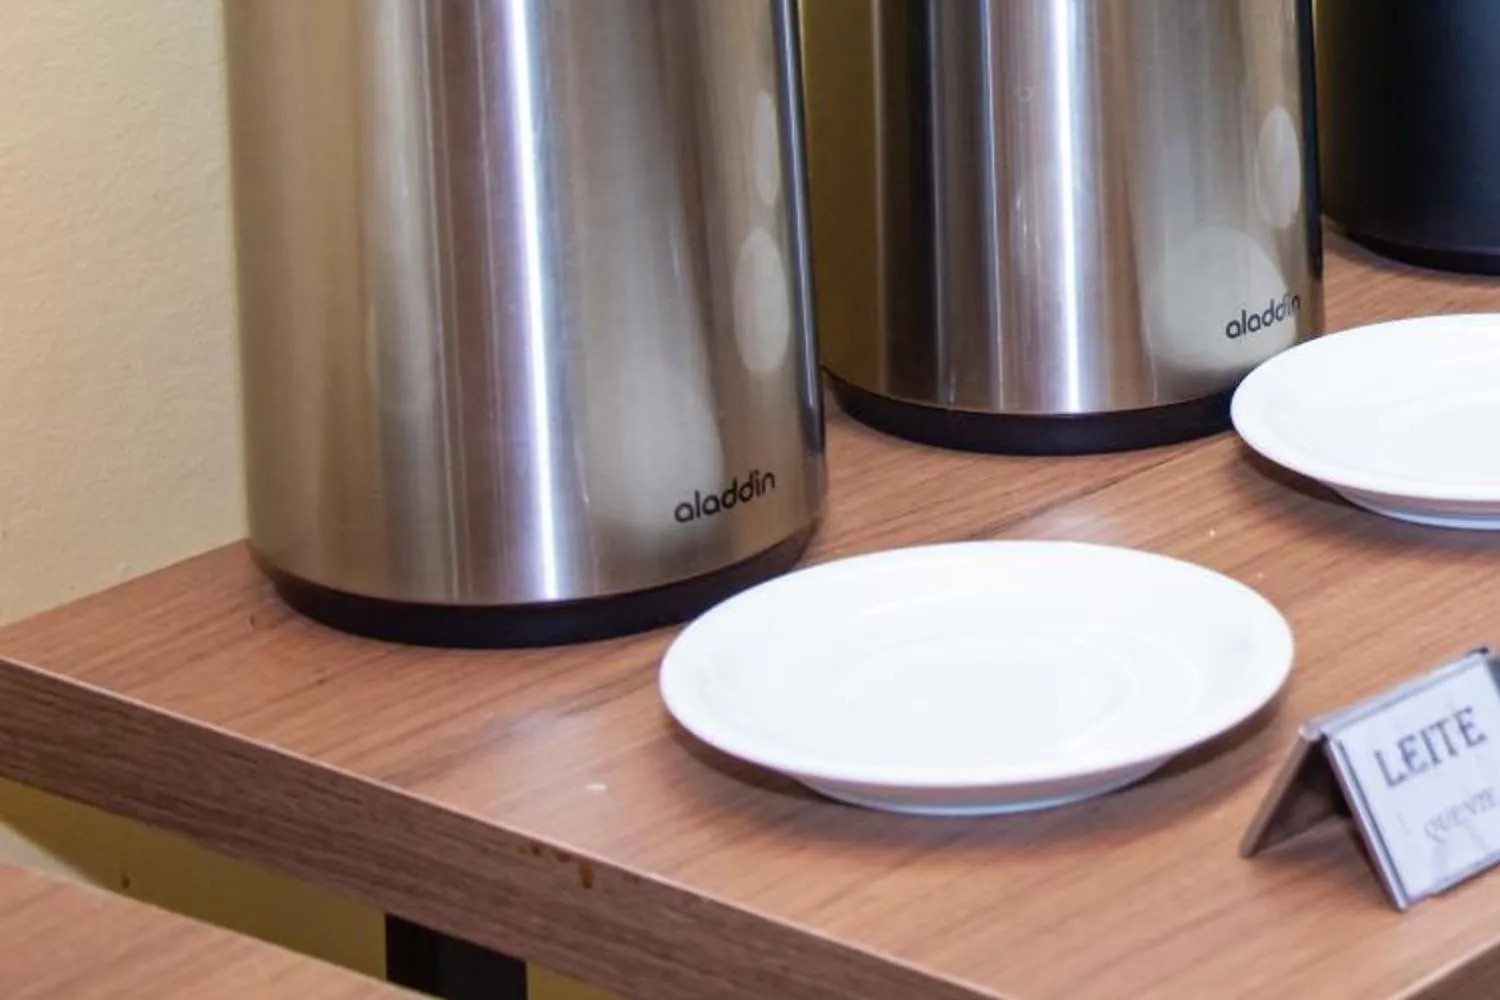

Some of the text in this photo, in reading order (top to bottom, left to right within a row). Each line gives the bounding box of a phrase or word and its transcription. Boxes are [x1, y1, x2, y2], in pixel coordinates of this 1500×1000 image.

[1225, 293, 1301, 339] aladdin
[674, 468, 776, 523] aladdin
[1373, 705, 1487, 788] LEITE
